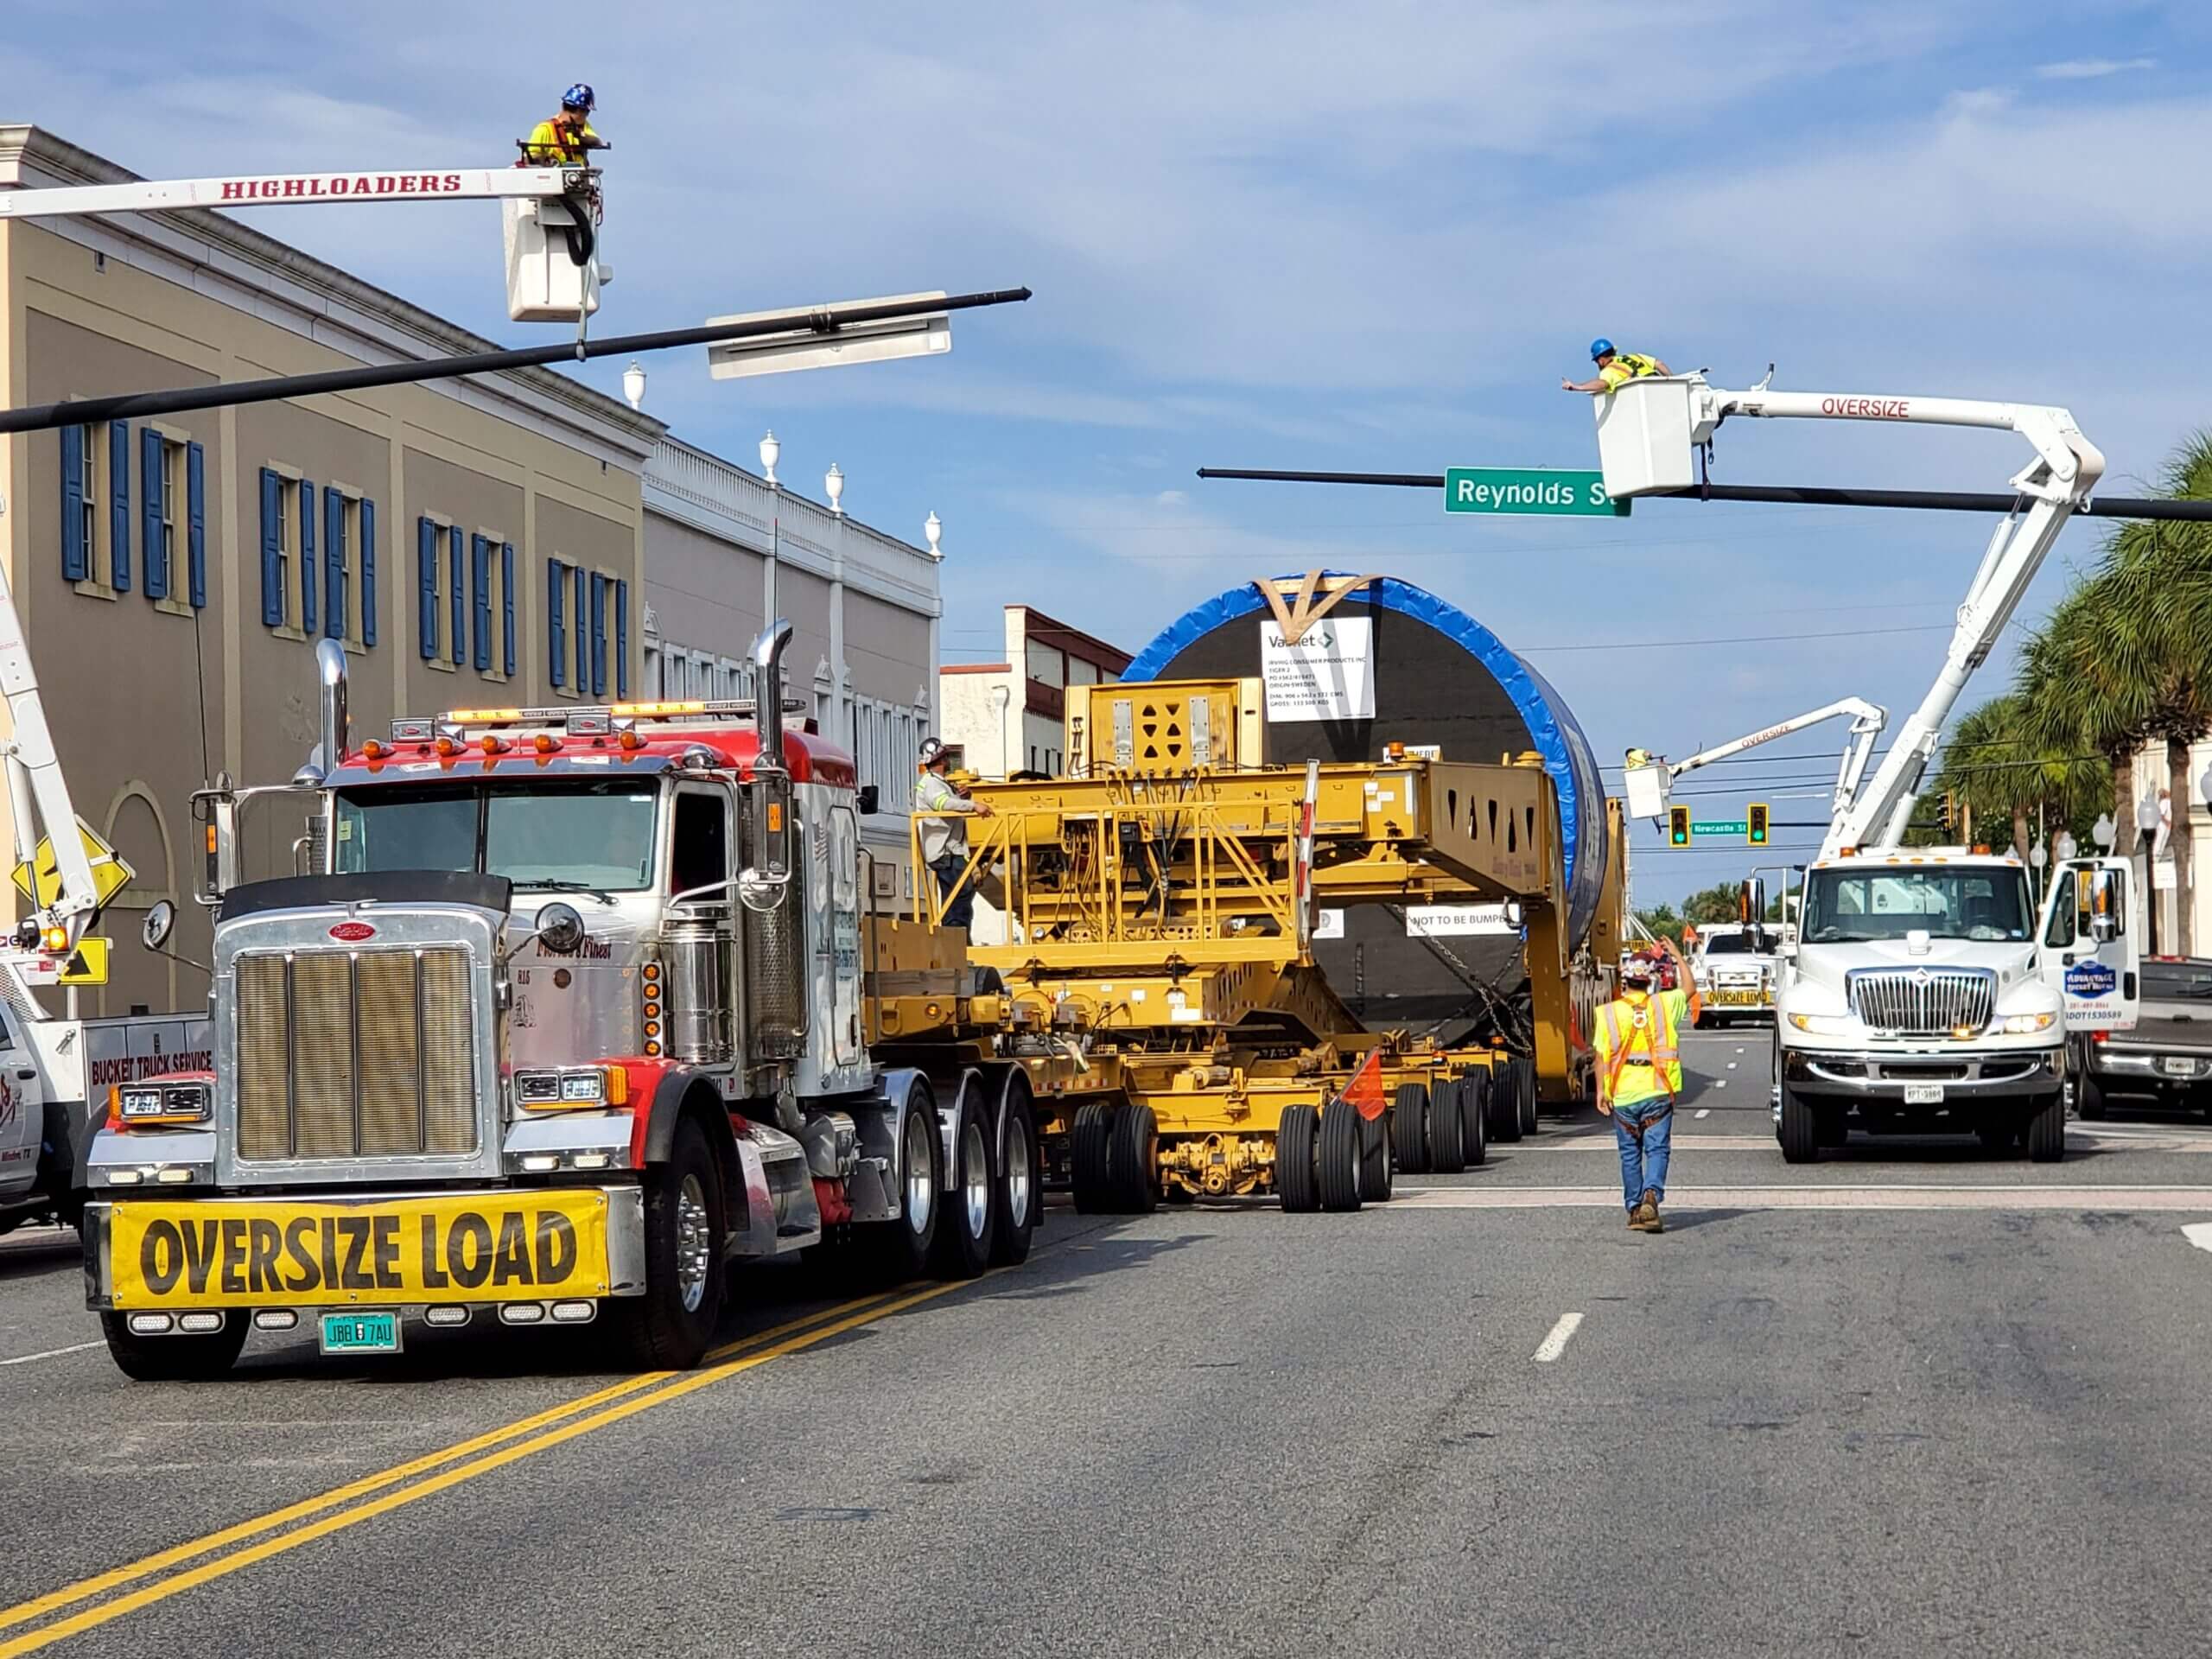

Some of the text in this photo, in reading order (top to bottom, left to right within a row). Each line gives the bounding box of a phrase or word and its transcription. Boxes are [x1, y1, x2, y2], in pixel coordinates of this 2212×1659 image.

[220, 175, 461, 200] HIGHLOADERS
[1821, 397, 1910, 418] OVERSIZE
[1458, 480, 1575, 509] Reynolds
[1268, 634, 1316, 648] Vaet
[1741, 724, 1791, 748] OVERSIZE
[1694, 824, 1734, 833] Newcastle
[1413, 915, 1433, 926] NOT
[1437, 915, 1451, 925] TO
[1454, 915, 1467, 925] BE
[1709, 990, 1768, 1002] OVERSIZE LOAD
[92, 1050, 213, 1086] BUCKET TRUCK SERVICE
[141, 1210, 578, 1295] OVERSIZE LOAD
